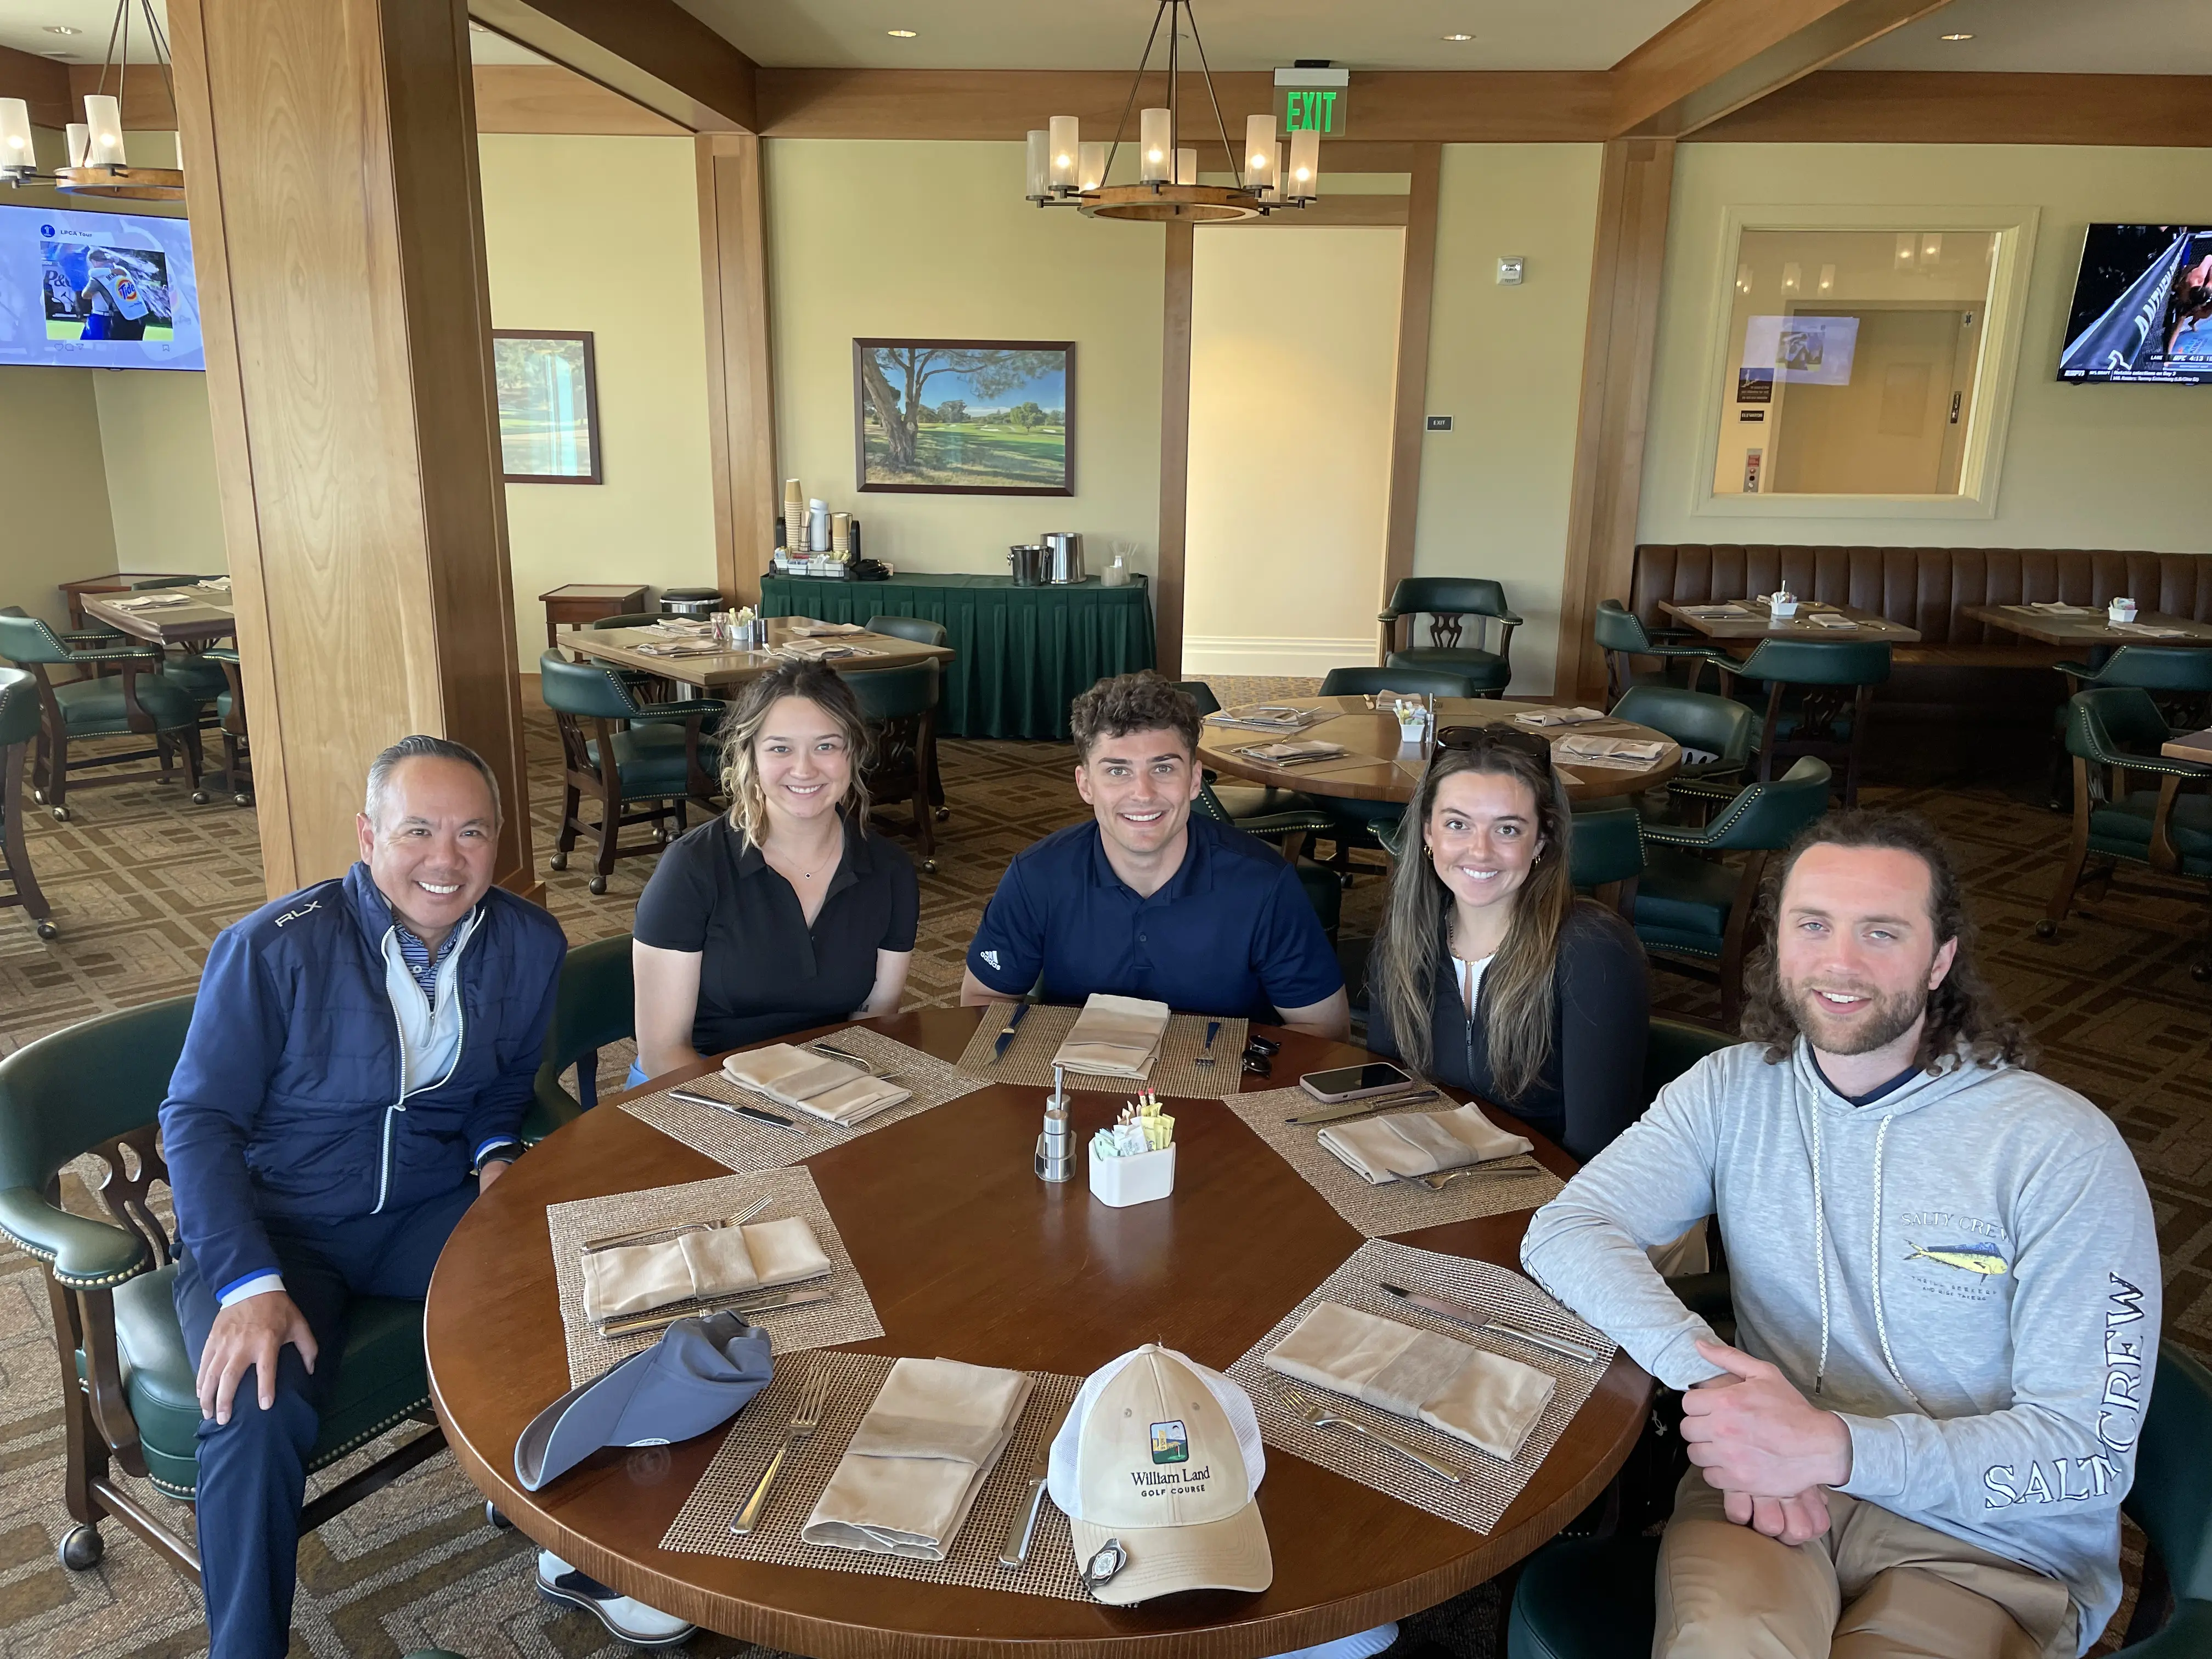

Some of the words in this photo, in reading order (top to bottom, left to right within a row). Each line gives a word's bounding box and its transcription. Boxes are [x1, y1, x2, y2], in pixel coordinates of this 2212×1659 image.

[1286, 92, 1336, 132] EXIT
[118, 281, 136, 300] Tide
[275, 900, 323, 927] RLX
[980, 951, 1001, 970] adidas
[1901, 1212, 1954, 1226] SALTY
[2095, 1271, 2145, 1453] CREW
[1131, 1471, 1180, 1486] William
[1182, 1465, 1210, 1482] Land
[1141, 1489, 1166, 1497] GOLF
[1171, 1485, 1205, 1494] COURSE
